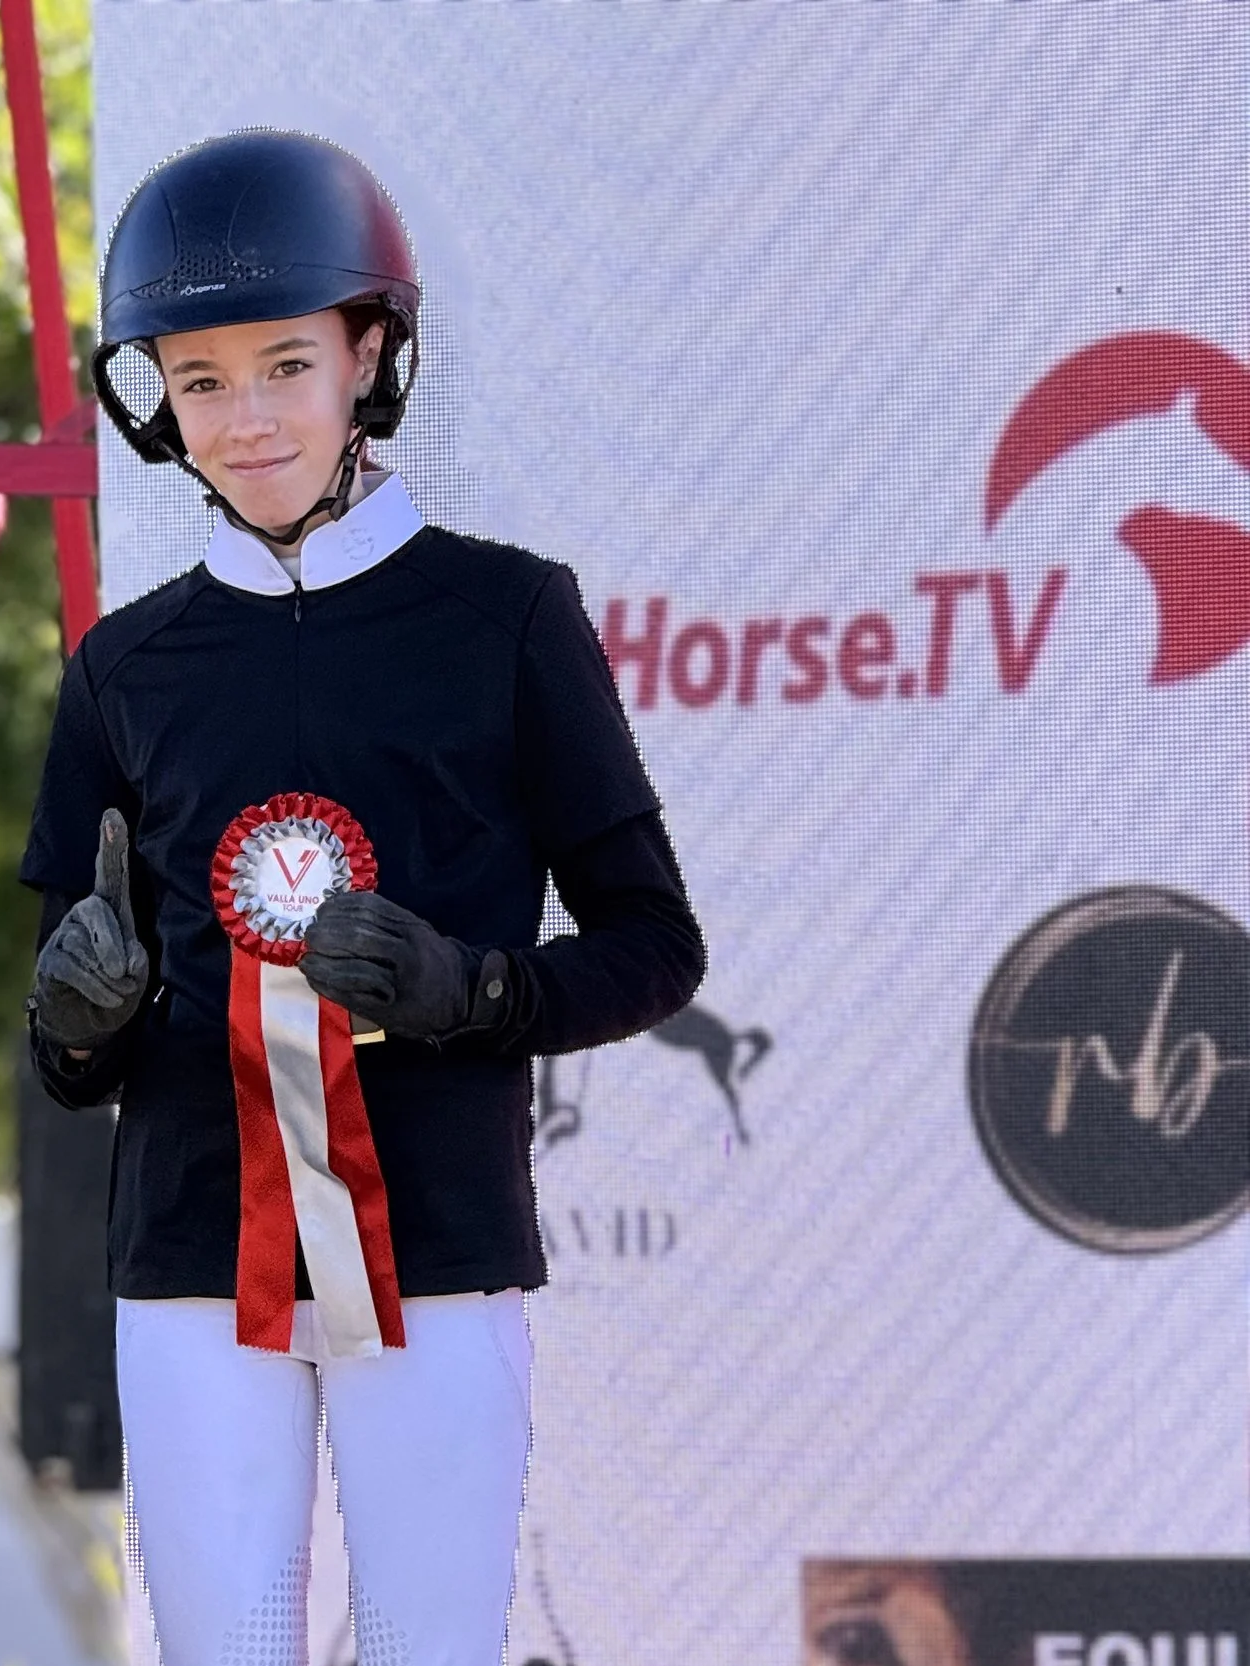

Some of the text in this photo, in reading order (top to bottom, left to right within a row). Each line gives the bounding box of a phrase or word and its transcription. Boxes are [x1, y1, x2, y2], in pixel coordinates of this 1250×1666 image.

[604, 566, 1068, 712] Horse.TV
[267, 894, 320, 904] VALLA UNO
[283, 904, 303, 912] TOUR
